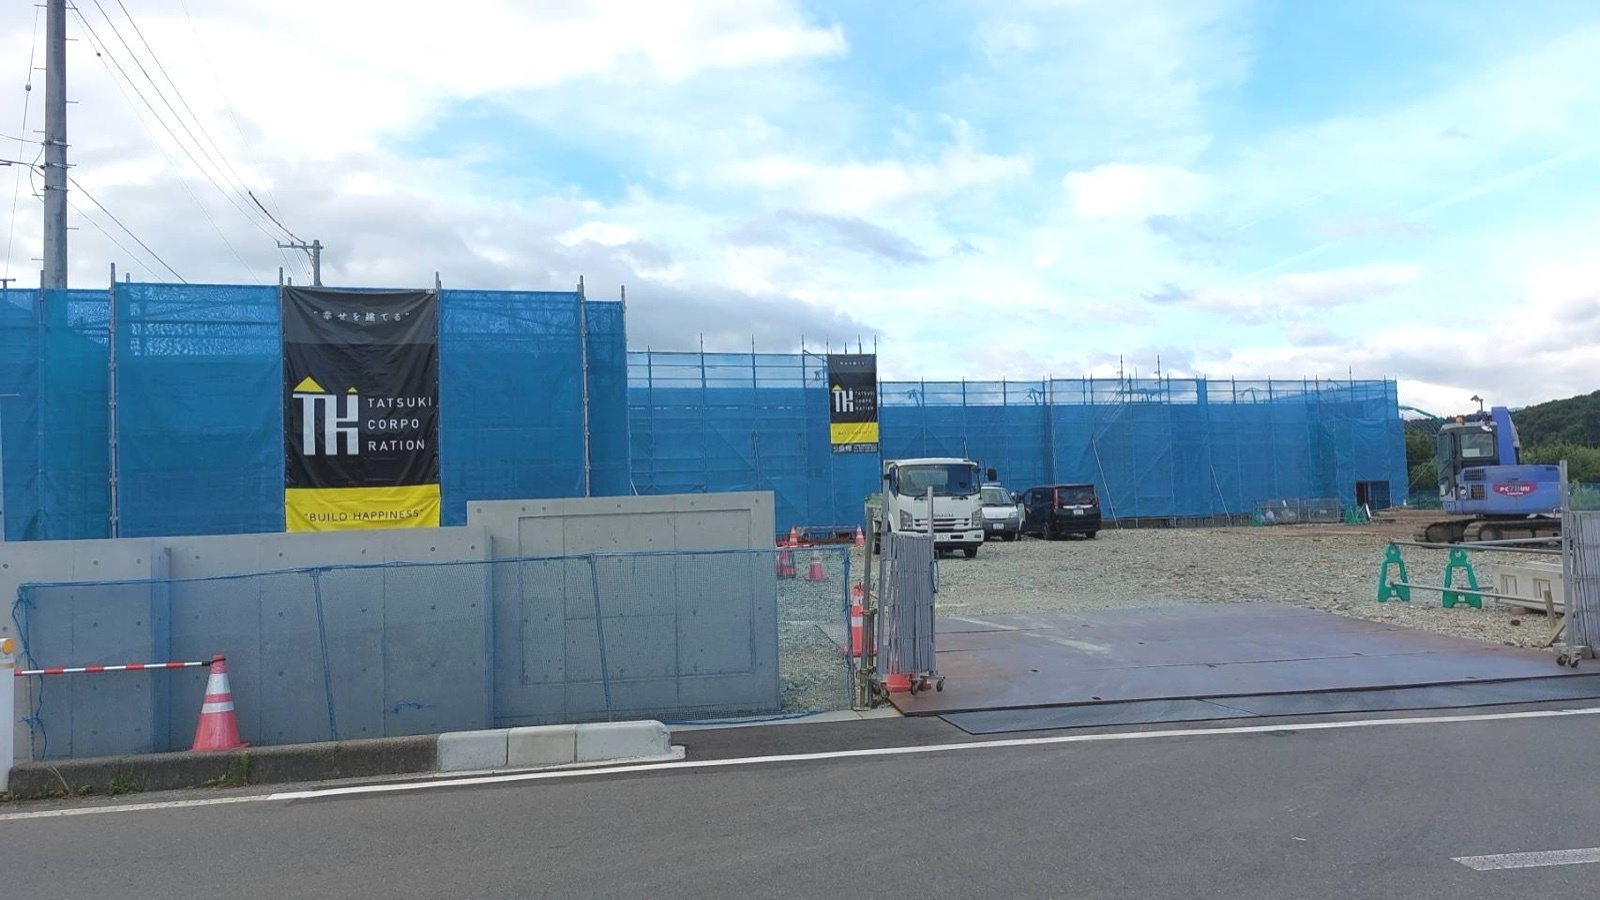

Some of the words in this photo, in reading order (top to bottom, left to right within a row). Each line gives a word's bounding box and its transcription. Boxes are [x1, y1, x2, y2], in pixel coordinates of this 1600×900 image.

[367, 396, 432, 409] TATSUKI
[367, 417, 420, 431] CORPO
[368, 439, 425, 452] RATION
